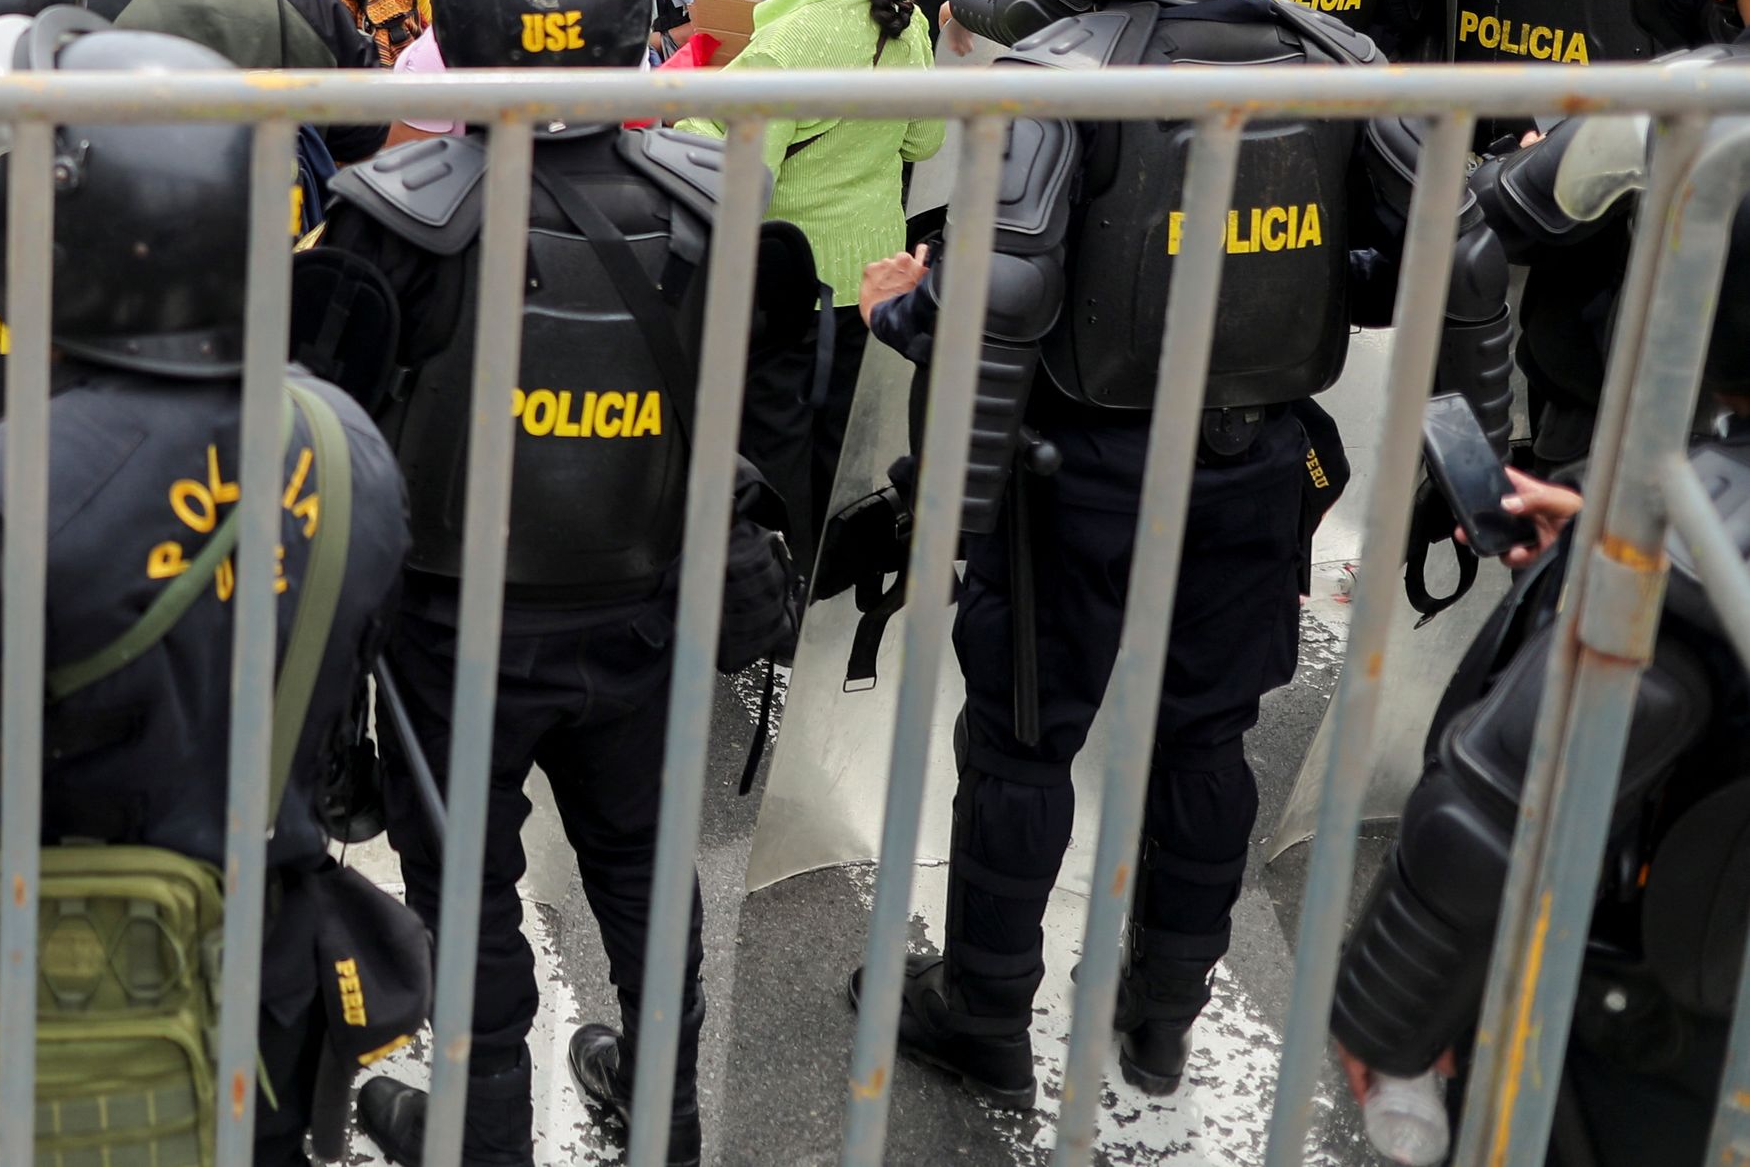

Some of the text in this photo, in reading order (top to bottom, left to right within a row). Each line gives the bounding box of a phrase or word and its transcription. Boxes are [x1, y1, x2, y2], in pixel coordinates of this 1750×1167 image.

[520, 10, 585, 53] USE
[1458, 10, 1590, 66] POLICIA
[1168, 203, 1322, 255] PLICIA
